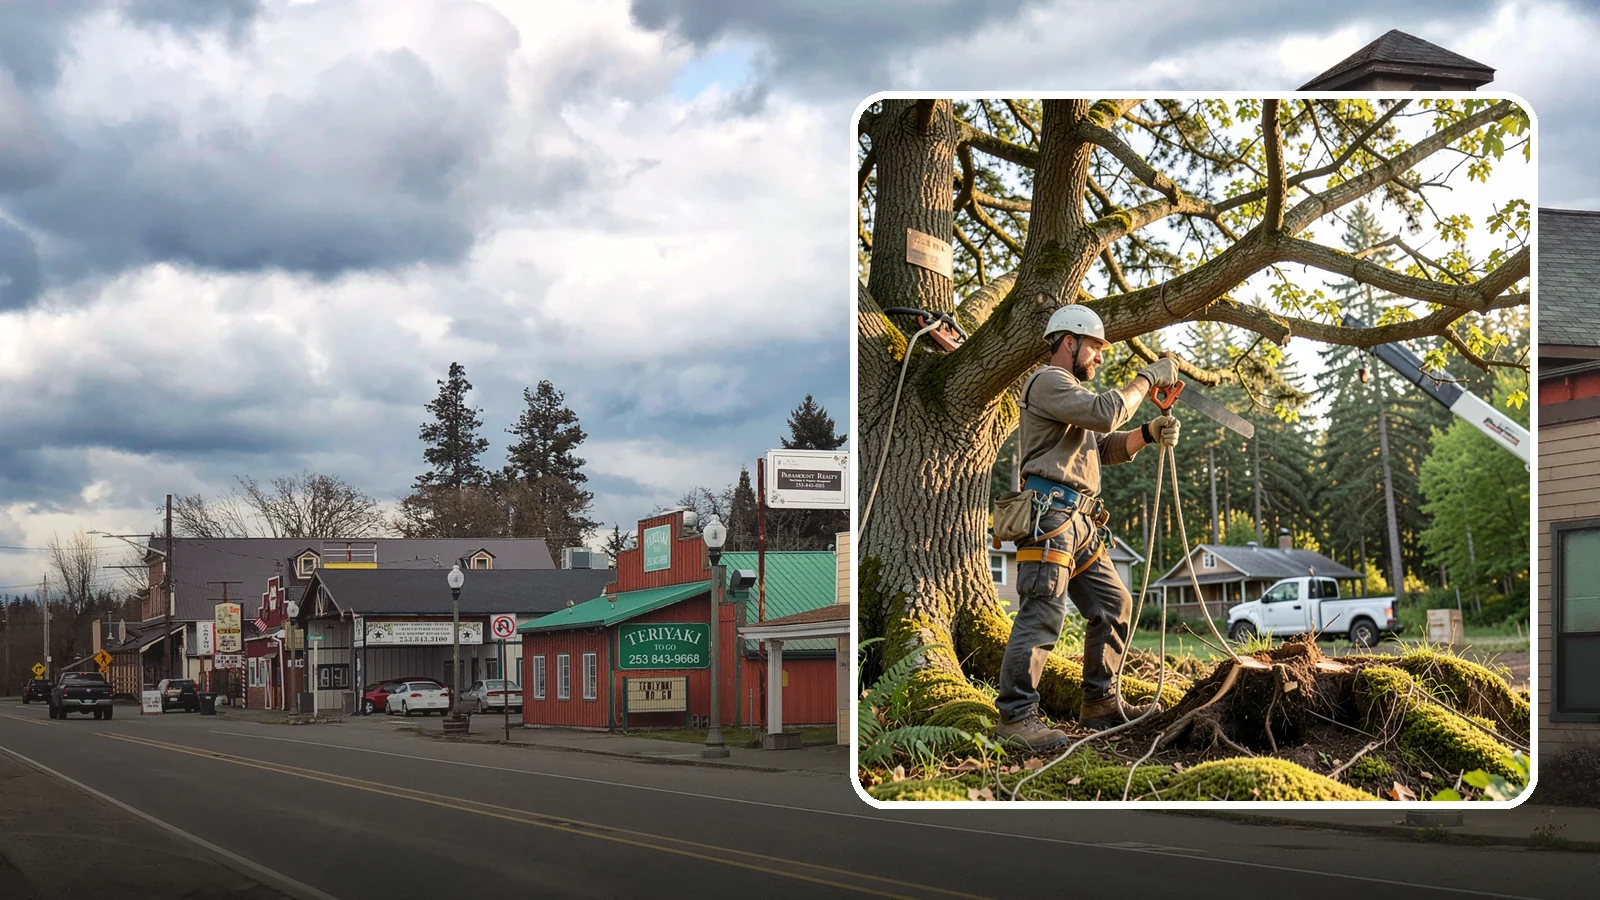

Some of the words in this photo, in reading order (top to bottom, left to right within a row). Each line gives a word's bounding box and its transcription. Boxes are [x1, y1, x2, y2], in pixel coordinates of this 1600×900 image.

[625, 627, 703, 646] TERIYAKI
[665, 643, 677, 651] GO
[628, 654, 649, 665] 253
[651, 653, 700, 664] 843-9668
[639, 681, 672, 691] TERIYAKI
